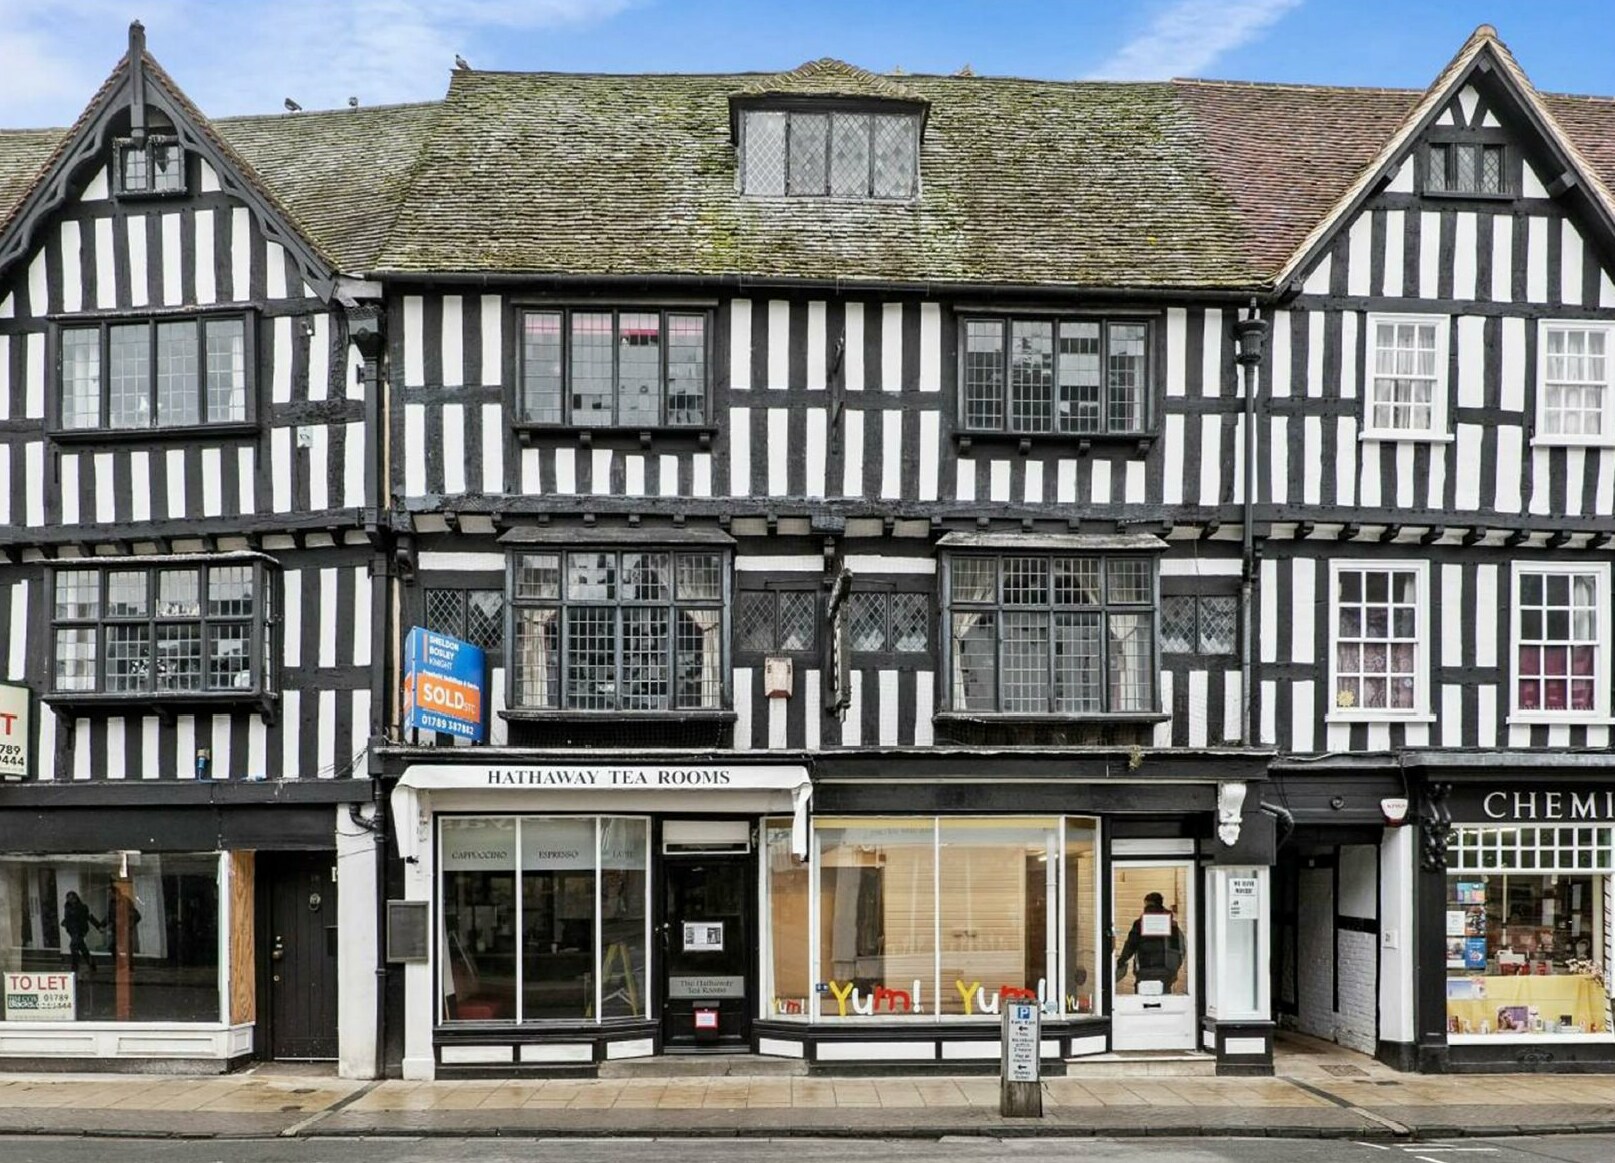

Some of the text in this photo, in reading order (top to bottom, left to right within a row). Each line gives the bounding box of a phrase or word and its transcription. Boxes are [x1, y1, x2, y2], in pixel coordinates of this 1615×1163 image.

[424, 682, 464, 710] SOLD
[488, 770, 731, 785] HATHAWAY TEA ROOMS
[1483, 791, 1615, 819] CHEMI
[9, 976, 68, 990] TO LET
[828, 979, 922, 1017] Yum!
